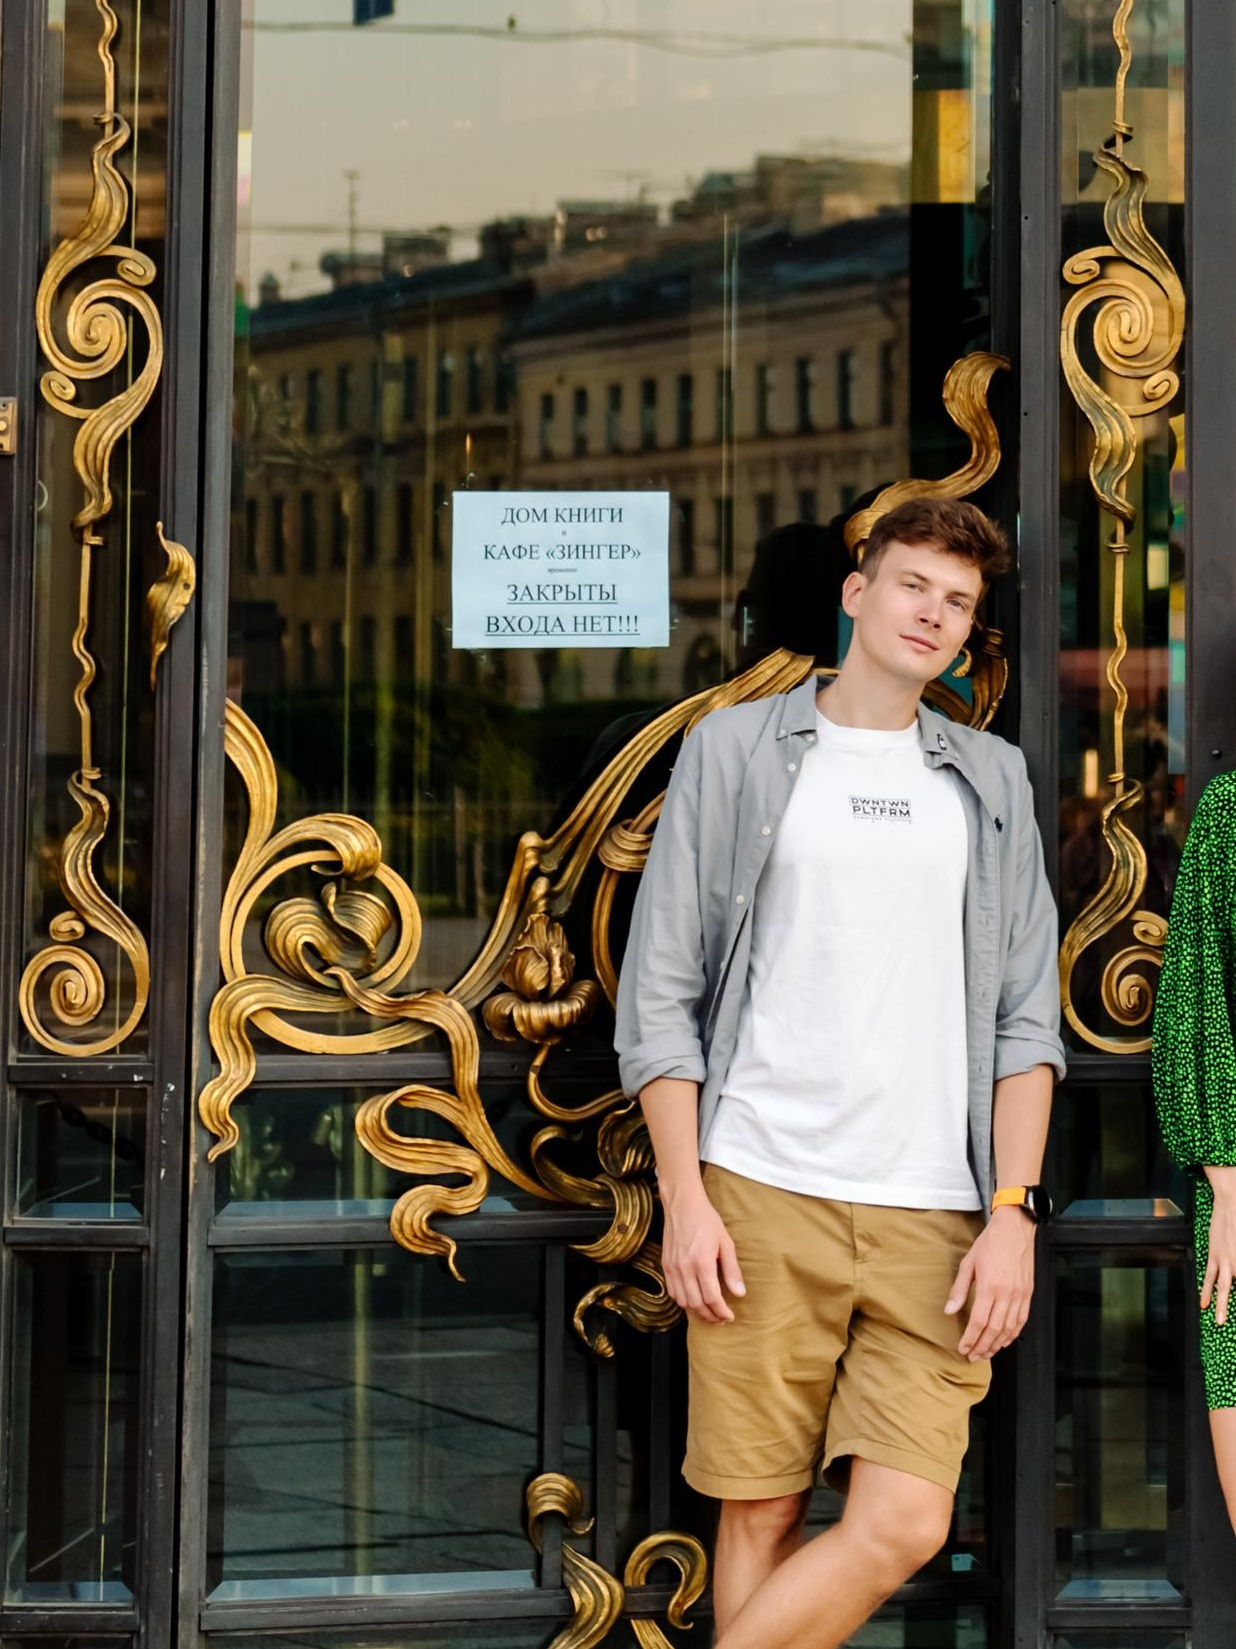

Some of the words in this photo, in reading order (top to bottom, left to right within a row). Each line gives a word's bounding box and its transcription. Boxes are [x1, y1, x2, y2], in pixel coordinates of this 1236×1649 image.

[501, 508, 547, 525] ДОМ
[554, 507, 624, 523] КНИГИ
[483, 544, 541, 560] КАФЕ
[546, 544, 641, 560] «ЗИНГЕР»
[507, 584, 617, 602] ЗАКРЫТЫ
[486, 615, 566, 635] ВХОДА
[573, 615, 639, 633] НЕТ!!!
[851, 798, 909, 807] DWNTWN
[853, 805, 910, 816] PLTFRM
